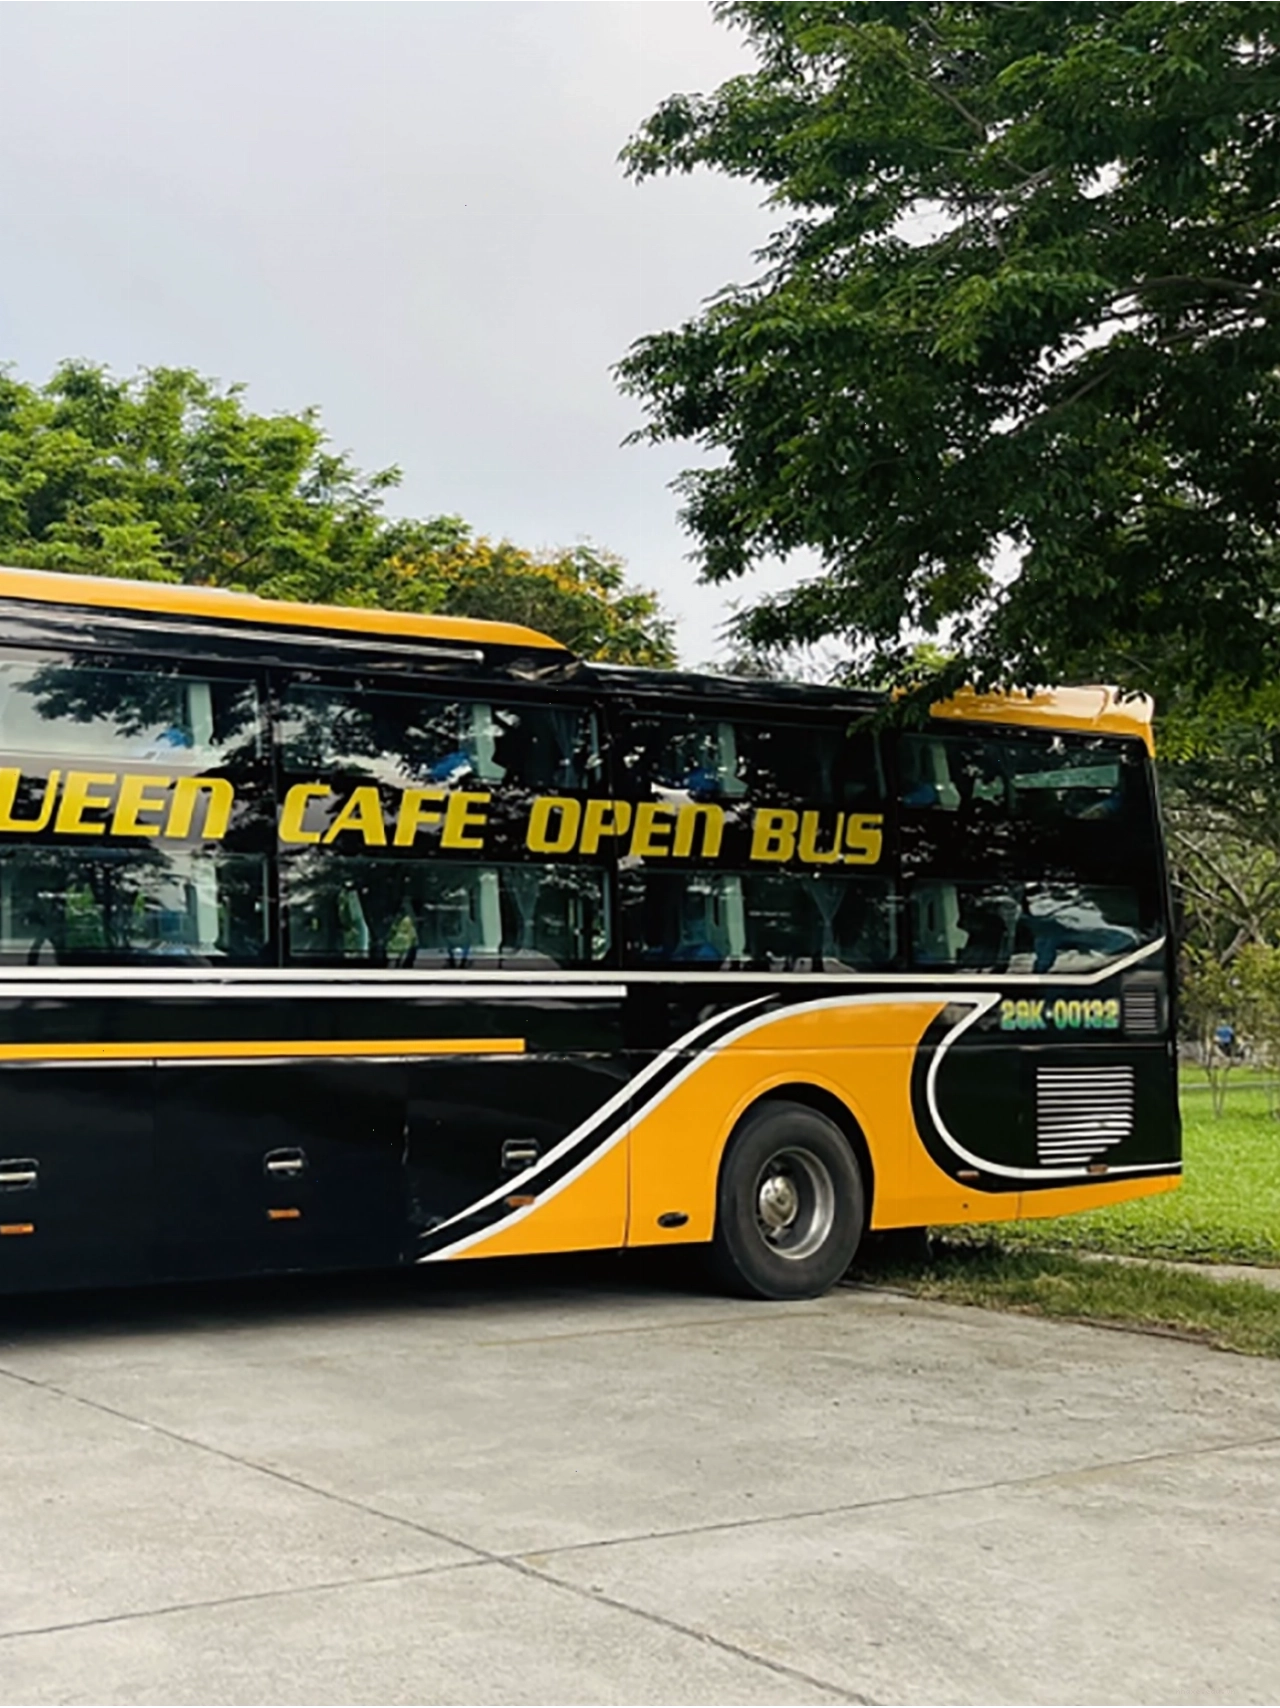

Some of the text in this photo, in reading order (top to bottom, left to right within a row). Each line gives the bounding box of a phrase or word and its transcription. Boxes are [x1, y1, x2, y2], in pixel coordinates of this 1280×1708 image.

[278, 781, 491, 849] CAFE
[526, 796, 724, 858] OPEN
[750, 807, 884, 865] BUS
